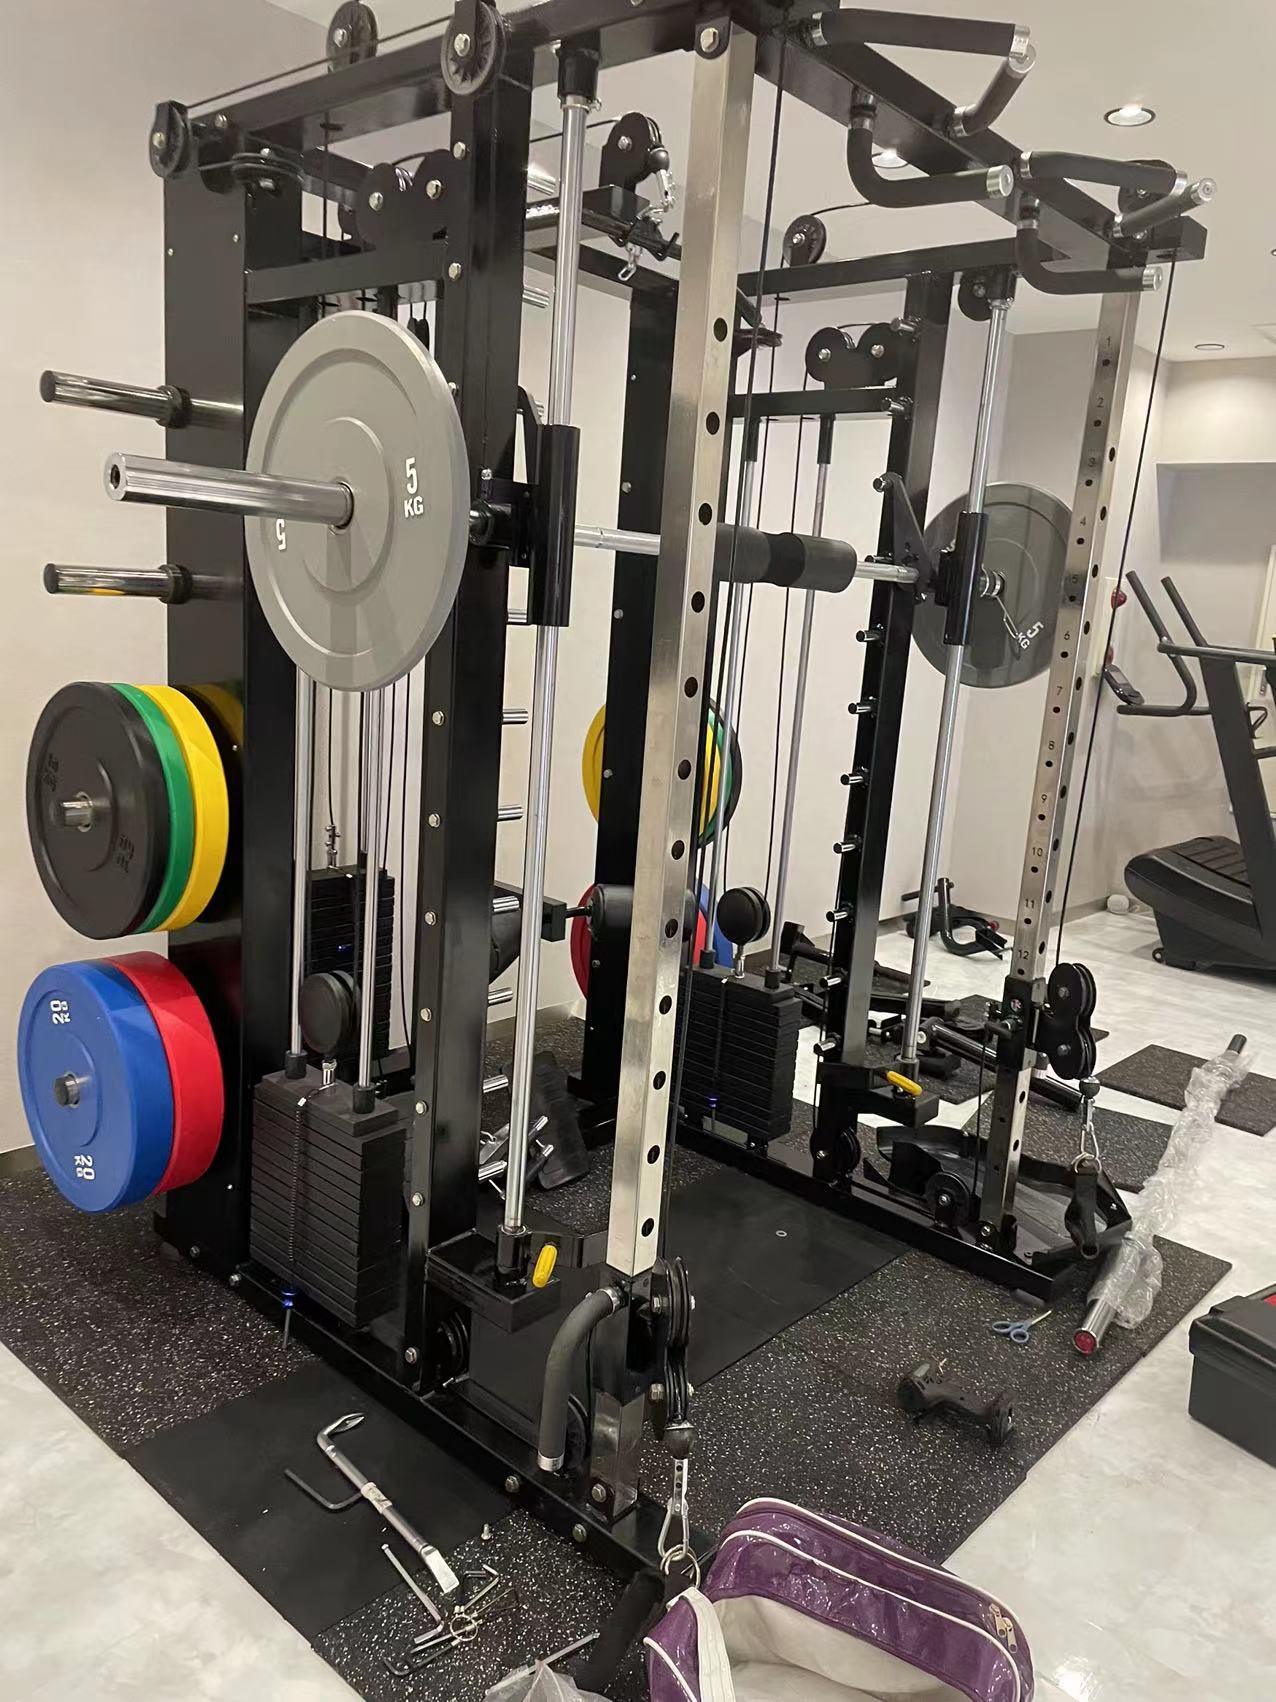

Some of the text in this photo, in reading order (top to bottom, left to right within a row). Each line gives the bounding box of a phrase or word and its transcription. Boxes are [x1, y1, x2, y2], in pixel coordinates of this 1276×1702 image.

[1096, 397, 1104, 408] 2
[405, 456, 418, 495] 5
[403, 495, 424, 518] KG
[1079, 516, 1087, 526] 4
[275, 518, 287, 551] 5
[1026, 621, 1045, 639] 5
[1063, 630, 1071, 641] 6
[1018, 632, 1031, 650] KG
[1056, 685, 1063, 696] 7
[1048, 740, 1055, 751] 8
[1040, 793, 1048, 804] 9
[1032, 847, 1043, 857] 10
[1025, 898, 1035, 909] 11
[1018, 949, 1029, 960] 12
[50, 999, 65, 1025] 20
[80, 1154, 96, 1181] 20
